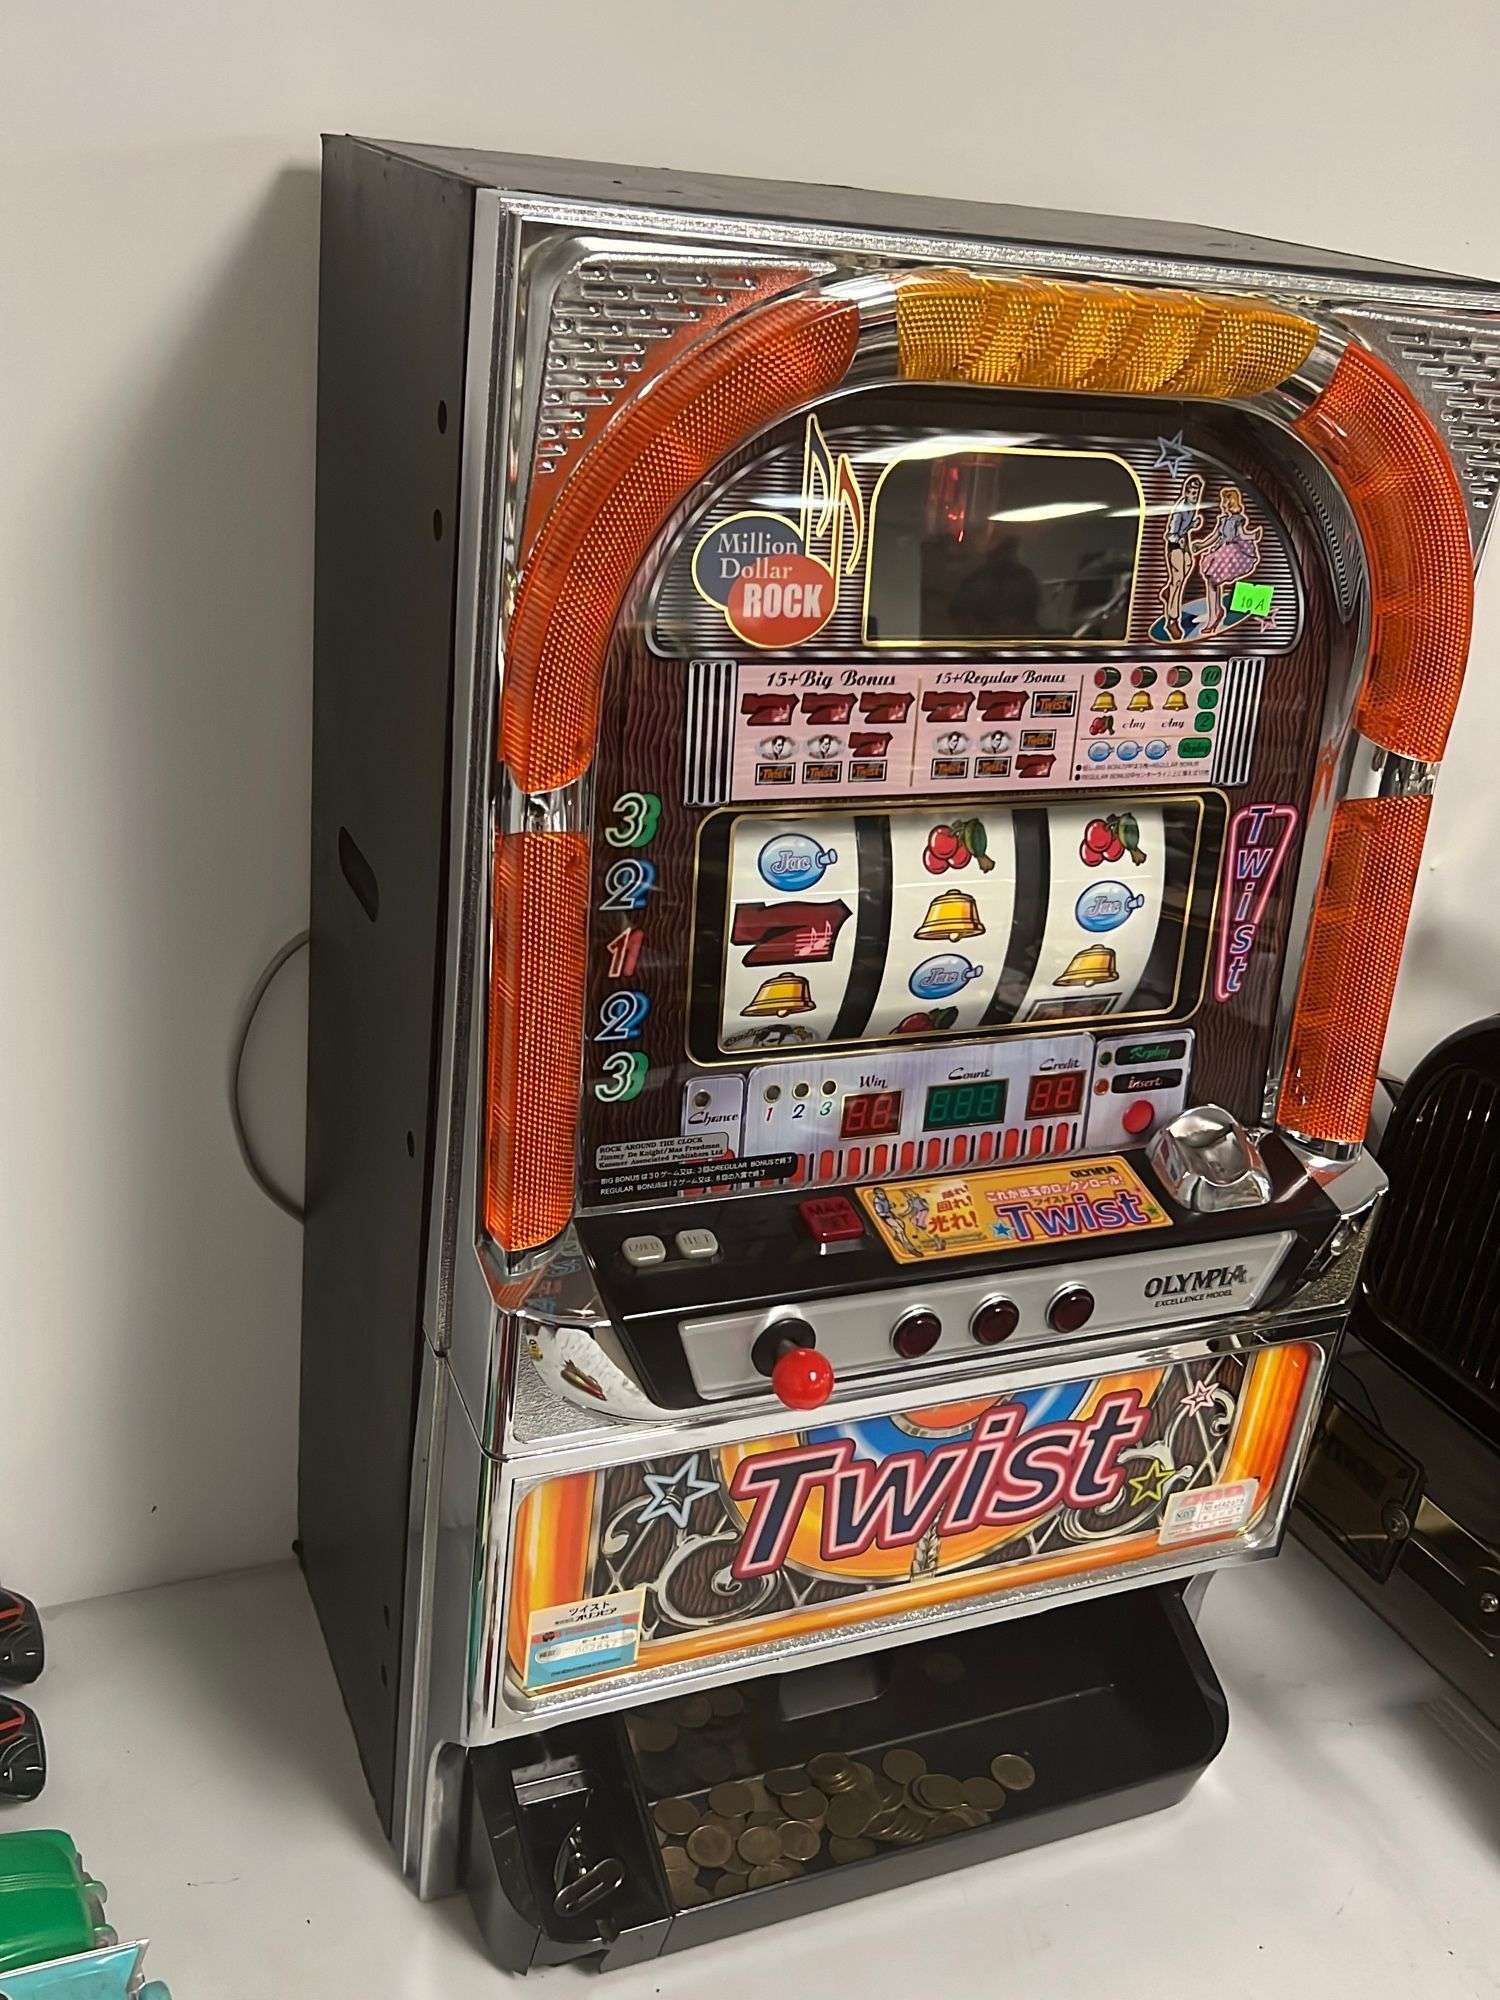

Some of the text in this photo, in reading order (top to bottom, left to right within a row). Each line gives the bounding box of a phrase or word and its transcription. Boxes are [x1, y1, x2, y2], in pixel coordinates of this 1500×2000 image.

[717, 531, 798, 555] Million
[719, 556, 793, 579] Dollar
[742, 583, 824, 619] ROCK
[840, 669, 896, 686] Bonus
[1022, 669, 1066, 684] Bonus
[1122, 717, 1185, 730] Any Any
[605, 792, 656, 848] 3
[770, 850, 812, 875] Jac
[600, 858, 651, 911] 2
[1226, 805, 1276, 993] Twist
[606, 927, 644, 978] 1
[594, 990, 646, 1042] 2
[948, 1067, 992, 1081] Count
[1039, 1057, 1081, 1072] Credit
[595, 1051, 645, 1103] 3
[859, 1074, 888, 1089] Win
[688, 1111, 739, 1126] Chance
[766, 1100, 833, 1122] 1 2 3
[600, 1136, 704, 1154] ROCK AROUND THE CLOCK
[600, 1178, 614, 1186] BIG
[614, 1174, 640, 1184] BONUS
[600, 1185, 634, 1196] REGULAR
[998, 1190, 1150, 1242] Twist
[1144, 1264, 1248, 1298] OLYMPIA
[1154, 1290, 1233, 1308] EXCELLENCE MODEL
[729, 1388, 1152, 1579] Twist
[569, 1601, 610, 1616] ツイスト
